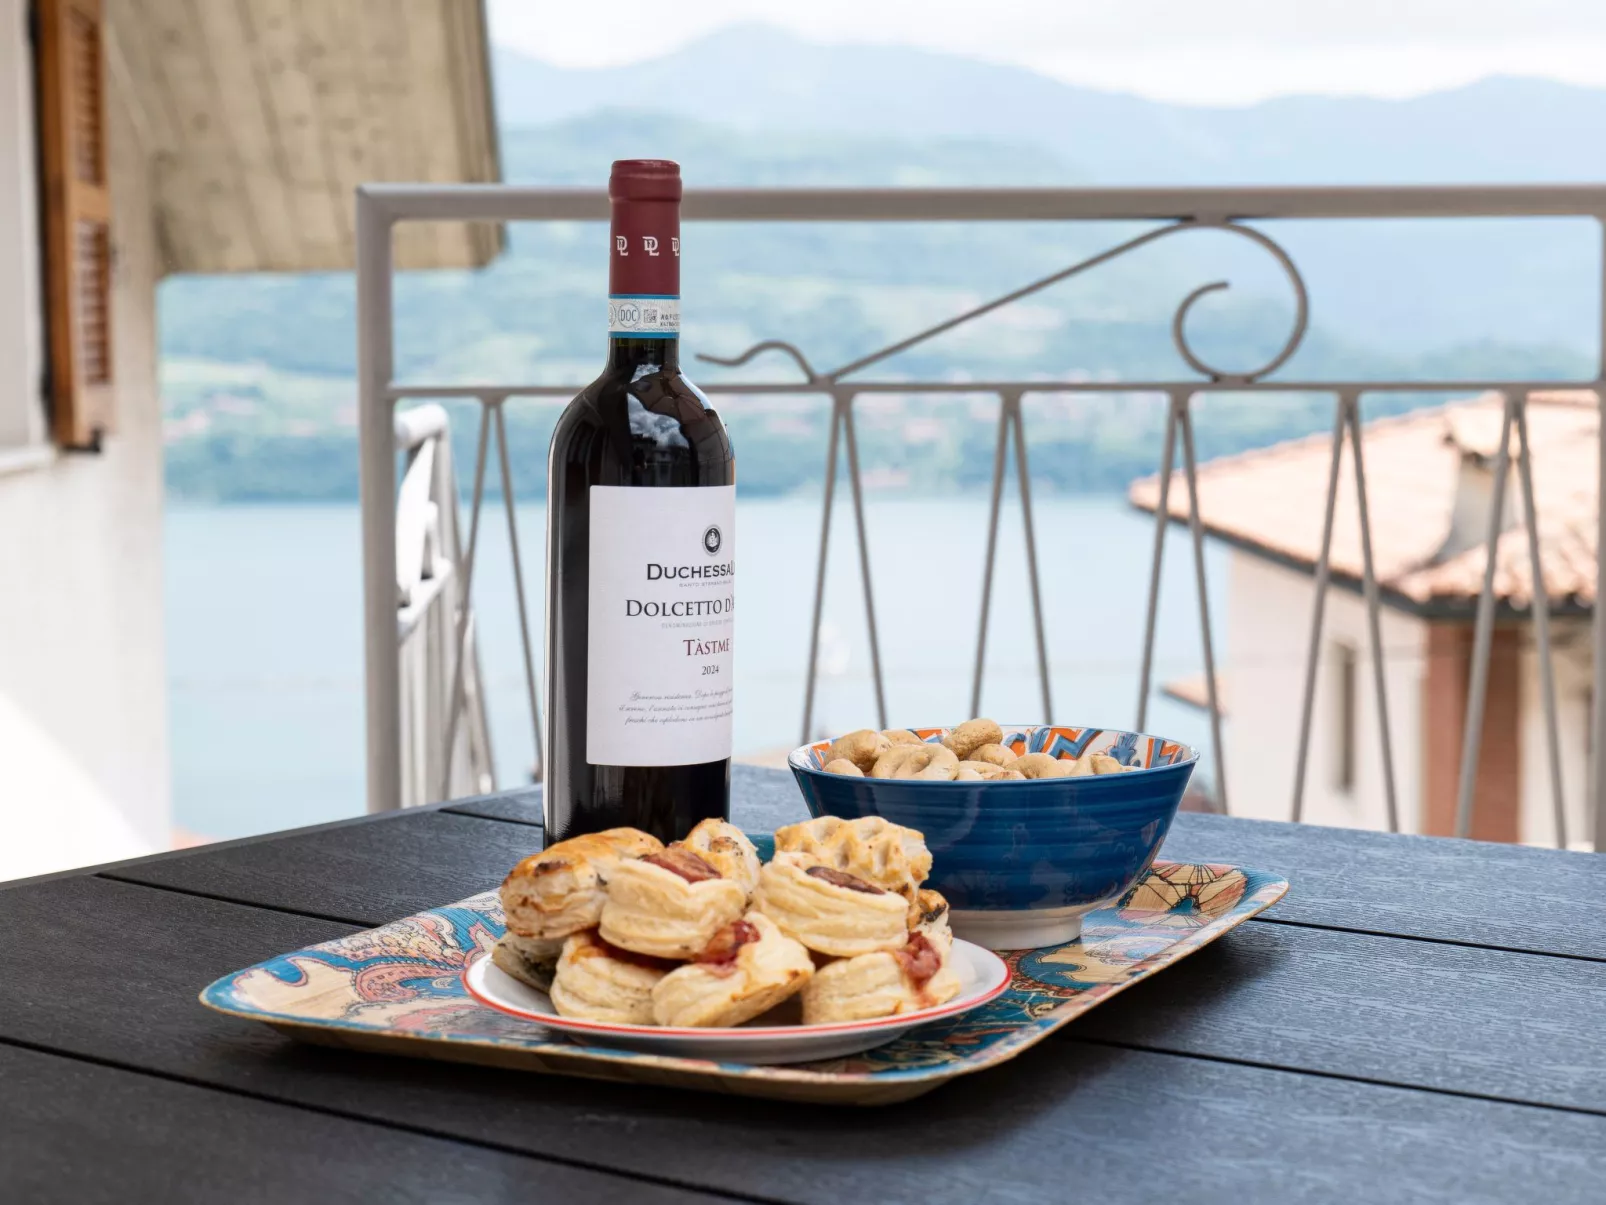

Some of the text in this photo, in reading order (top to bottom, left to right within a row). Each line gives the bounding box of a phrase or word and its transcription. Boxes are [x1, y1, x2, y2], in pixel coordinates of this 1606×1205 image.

[620, 309, 637, 322] DOC
[625, 598, 722, 617] DOLCETTO
[702, 664, 719, 675] 2024
